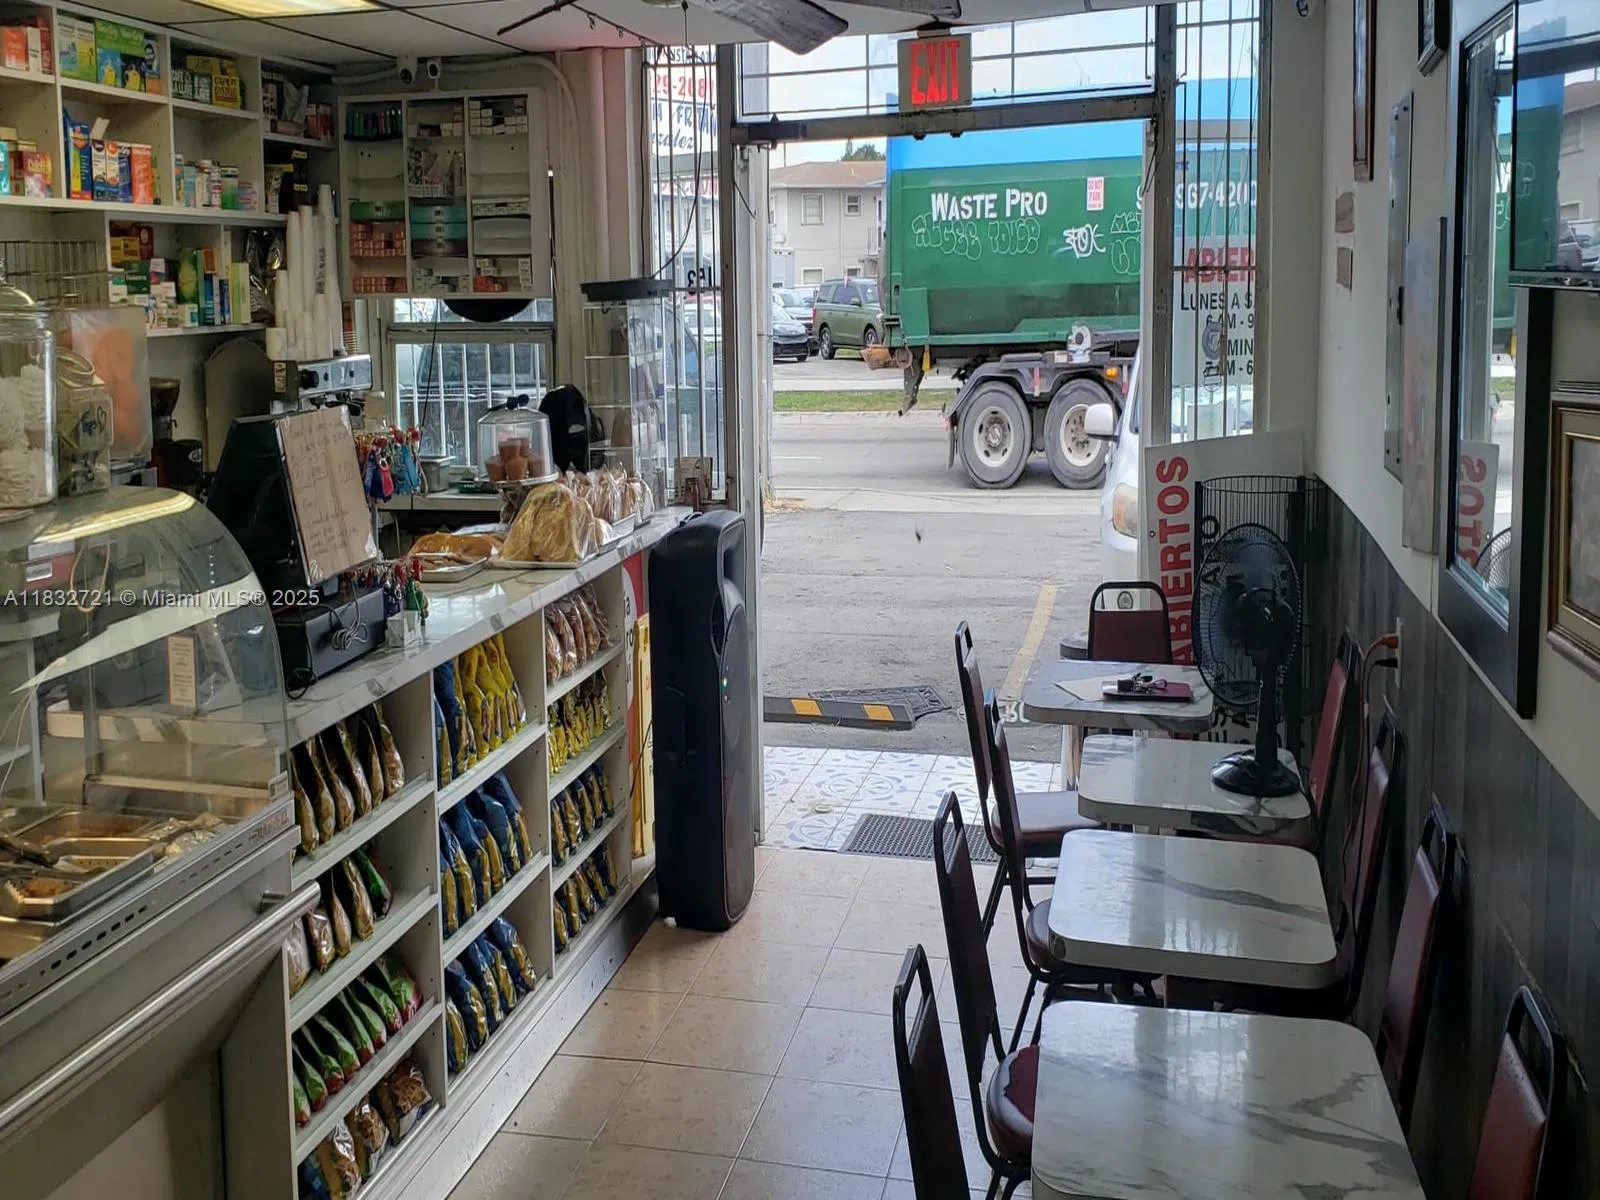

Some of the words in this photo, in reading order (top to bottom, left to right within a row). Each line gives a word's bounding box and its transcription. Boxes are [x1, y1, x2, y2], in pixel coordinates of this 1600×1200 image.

[911, 39, 960, 105] EXIT
[1181, 293, 1225, 311] LUNES
[1156, 455, 1192, 665] ABIERTOS
